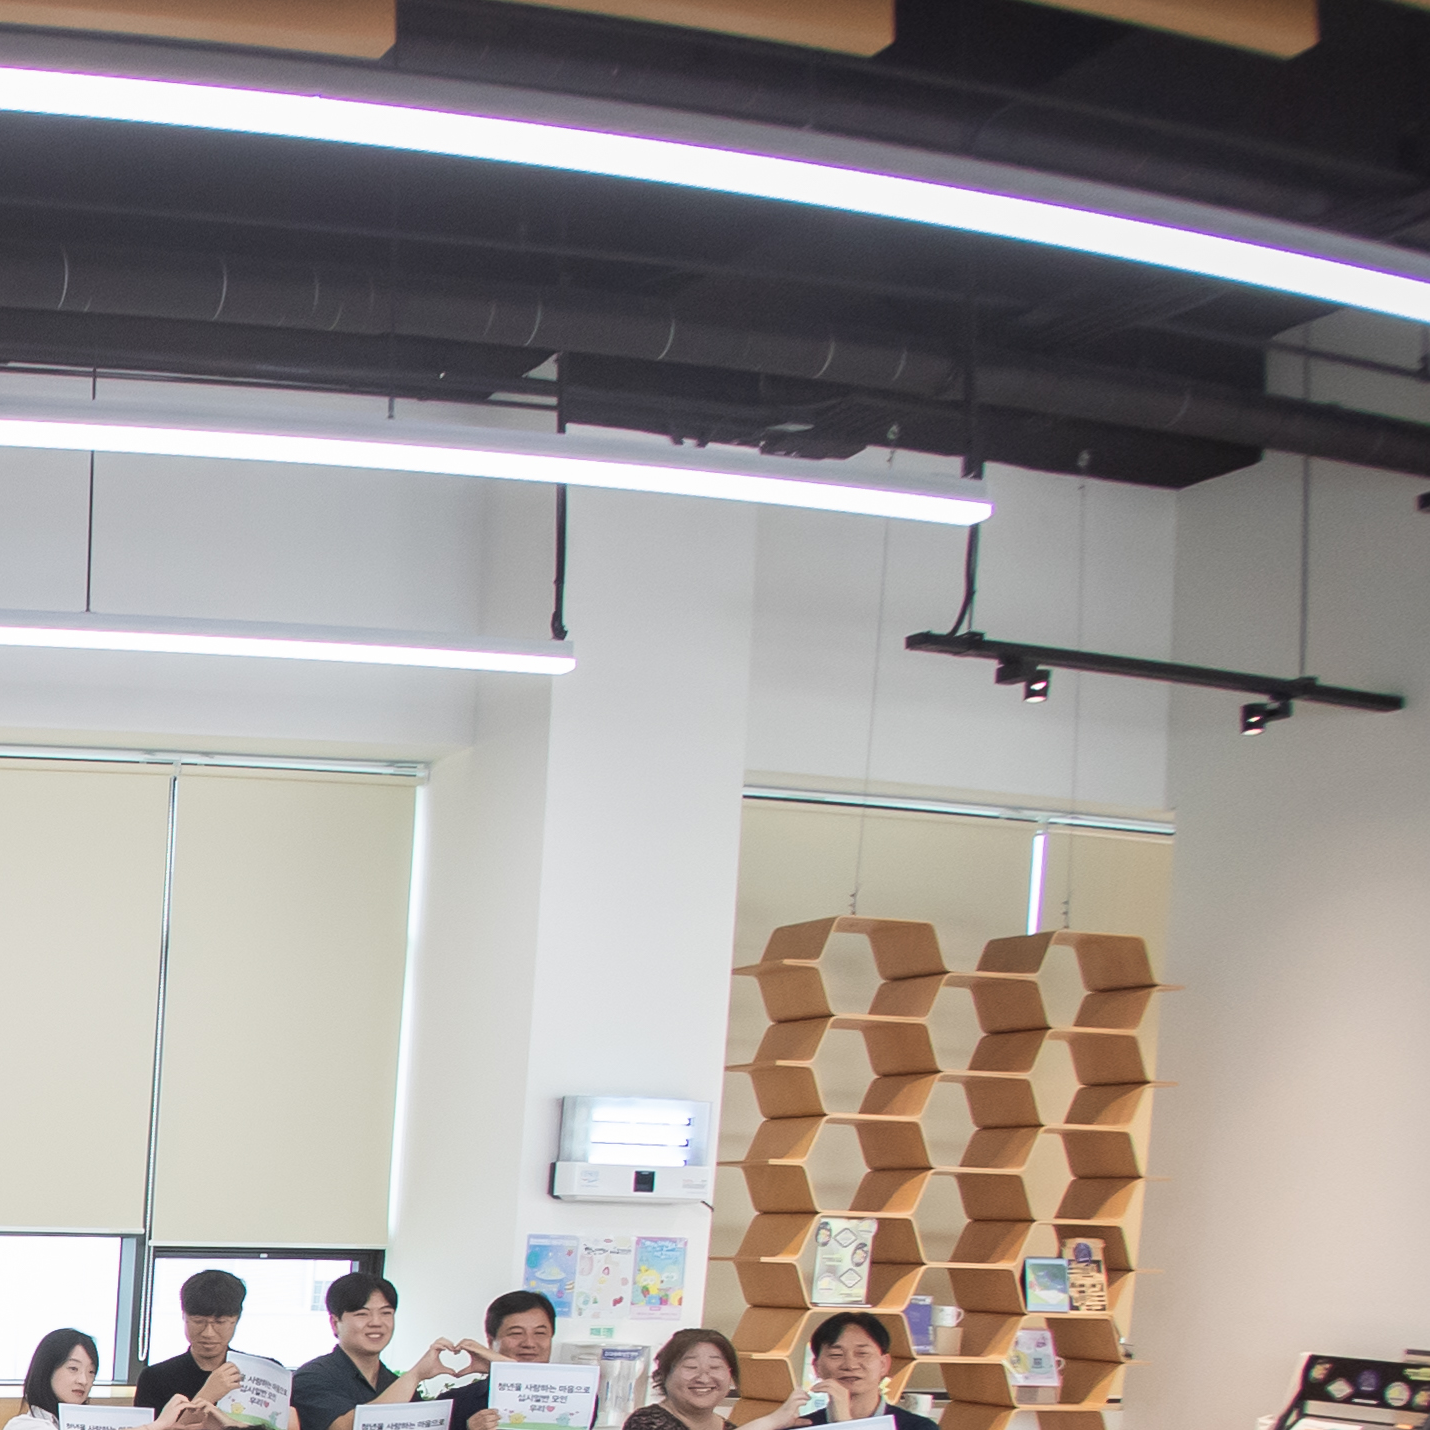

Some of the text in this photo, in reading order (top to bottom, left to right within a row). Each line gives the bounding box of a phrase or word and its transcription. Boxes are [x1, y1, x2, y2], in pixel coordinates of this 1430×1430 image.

[498, 1383, 521, 1391] 청년을
[525, 1384, 556, 1393] 사랑하는
[518, 1395, 568, 1404] 십시일반 모인
